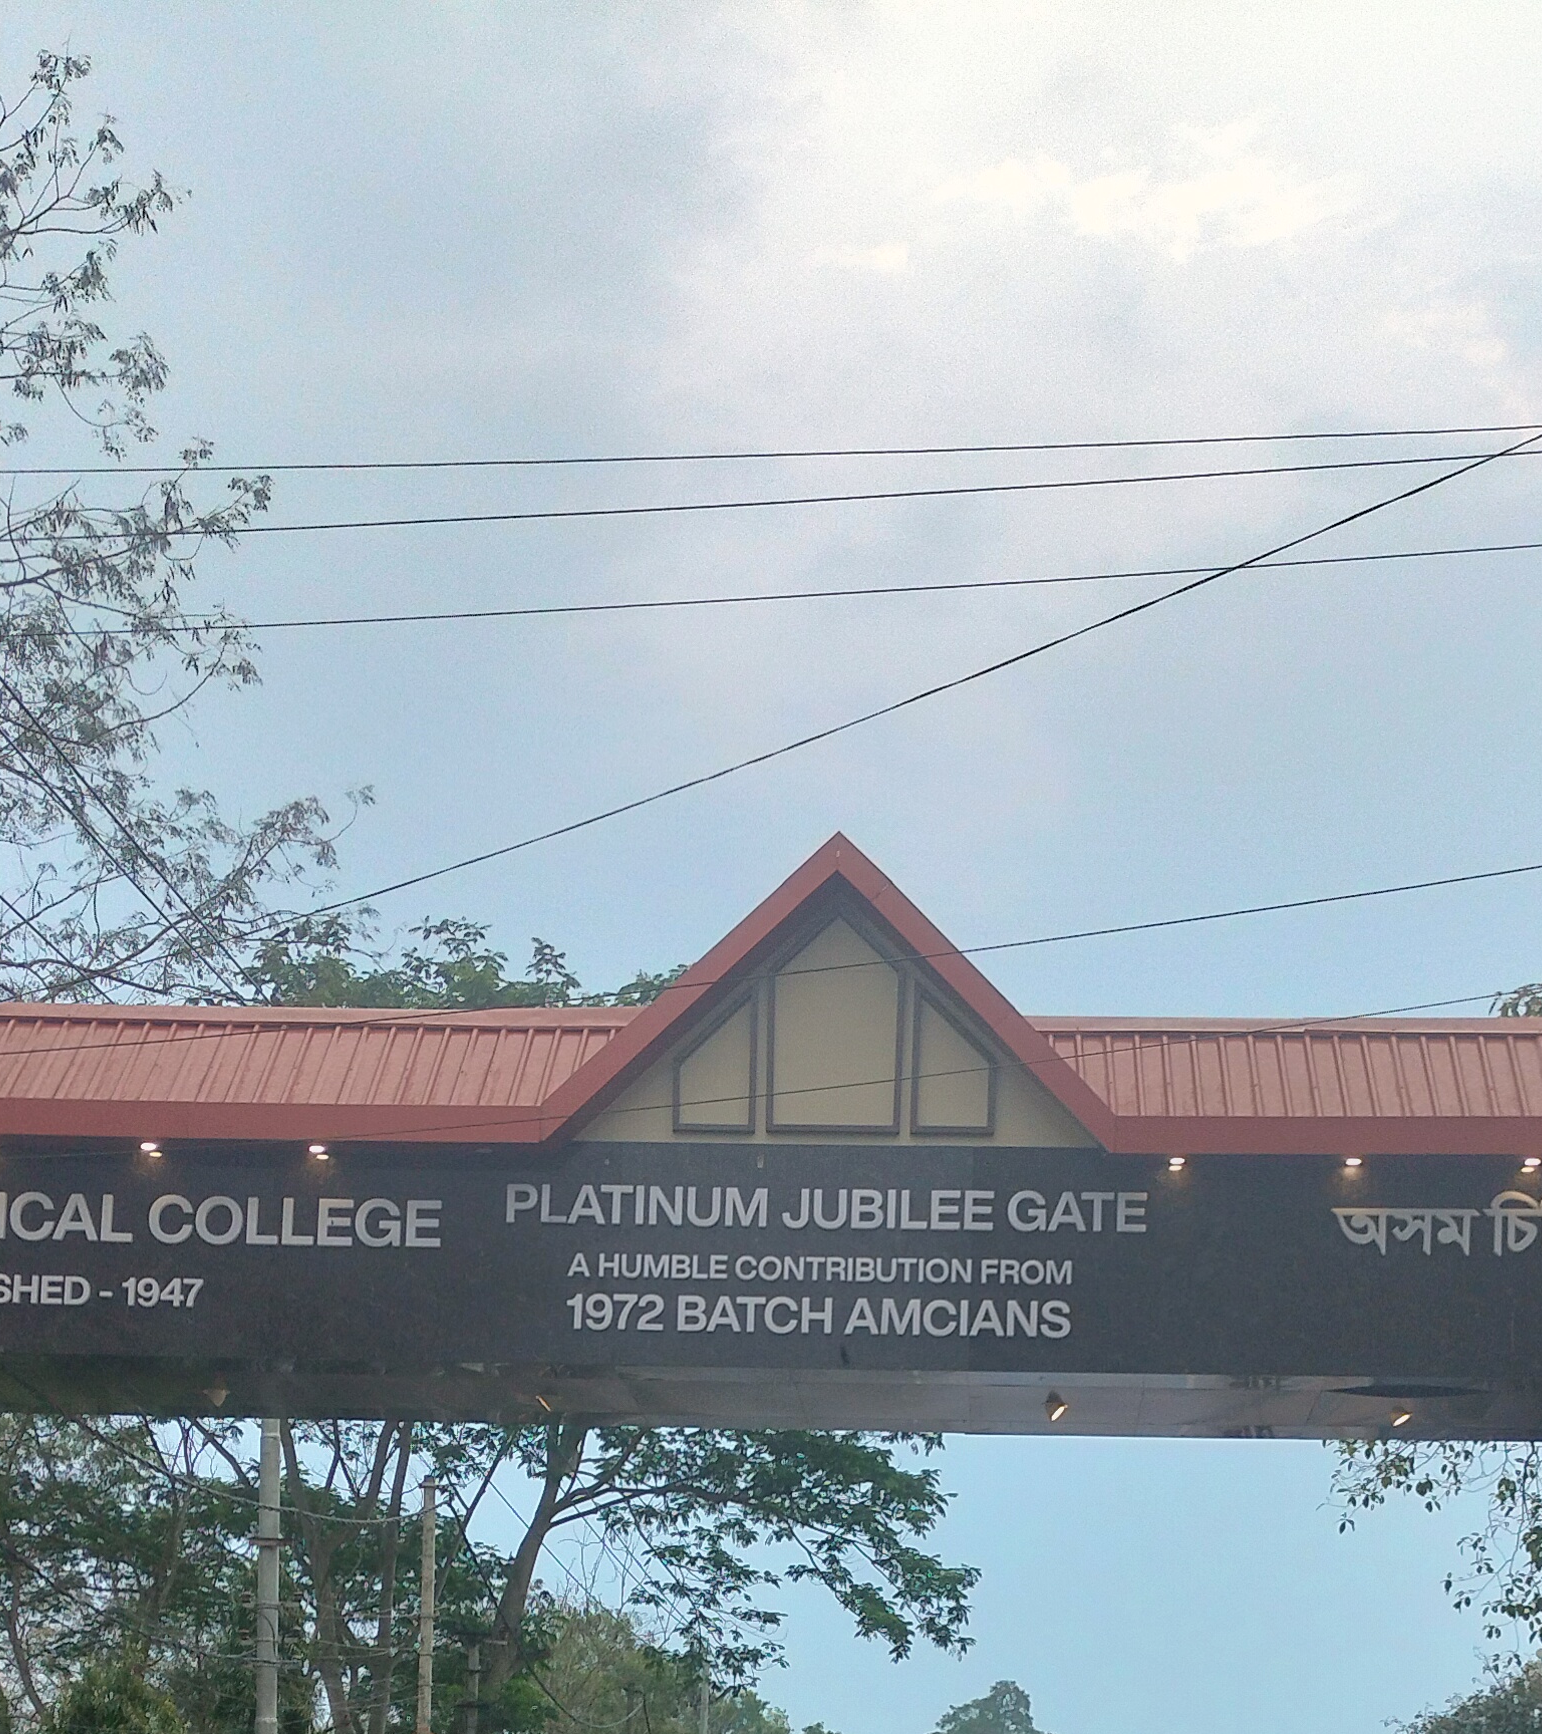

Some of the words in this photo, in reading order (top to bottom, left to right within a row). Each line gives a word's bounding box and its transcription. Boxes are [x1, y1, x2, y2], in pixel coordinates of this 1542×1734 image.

[148, 1195, 442, 1249] COLLEGE
[506, 1184, 769, 1229] PLATINUM
[782, 1189, 994, 1232] JUBILEE
[1007, 1191, 1148, 1234] GATE
[1331, 1207, 1481, 1256] অসম
[121, 1277, 204, 1308] 1947
[568, 1253, 590, 1278] A
[598, 1254, 728, 1281] HUMBLE
[735, 1255, 973, 1285] CONTRIBUTION
[981, 1259, 1073, 1285] FROM
[567, 1293, 665, 1333] 1972
[677, 1296, 834, 1335] BATCH
[845, 1298, 1072, 1339] AMCIANS
